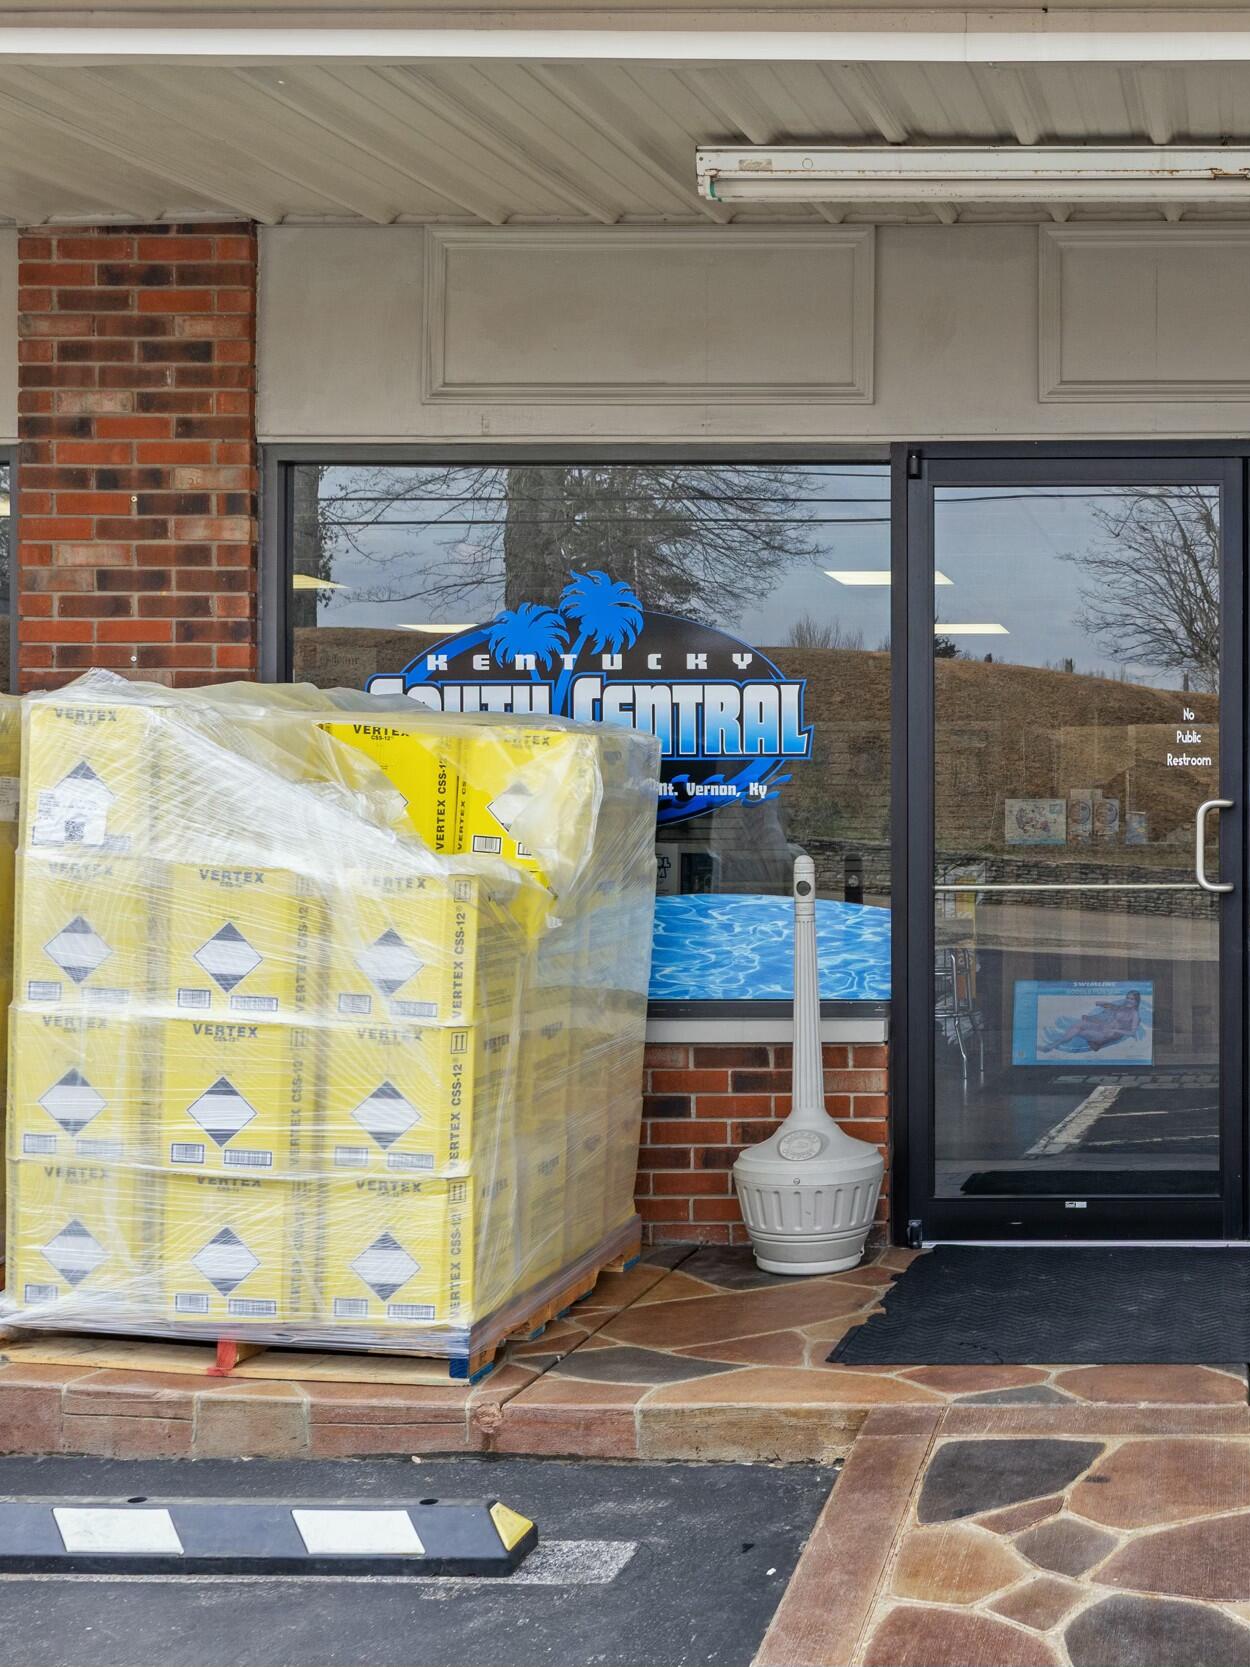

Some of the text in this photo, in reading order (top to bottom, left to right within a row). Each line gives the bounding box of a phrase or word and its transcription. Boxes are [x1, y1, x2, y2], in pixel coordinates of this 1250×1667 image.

[427, 654, 753, 671] KENTUCKY
[54, 708, 117, 722] VERTEX
[1183, 708, 1195, 721] No
[353, 724, 410, 736] VERTE
[1176, 730, 1202, 743] Public
[1167, 753, 1212, 766] Restroom
[686, 782, 741, 797] Vernon,
[749, 782, 768, 799] Ky
[436, 799, 446, 850] VERTEX
[457, 800, 466, 850] VERTEX
[200, 869, 265, 883] VERTEX
[452, 961, 464, 1018] VERTEX
[43, 1016, 107, 1028] VERTEX
[193, 1024, 258, 1038] VERTEX
[357, 1030, 423, 1041] VERTEX
[289, 1108, 302, 1166] VERTEX
[449, 1112, 461, 1168] VERTEX
[196, 1177, 262, 1187] VERTEX
[356, 1180, 422, 1193] VERTEX
[450, 1262, 461, 1316] VERTEX
